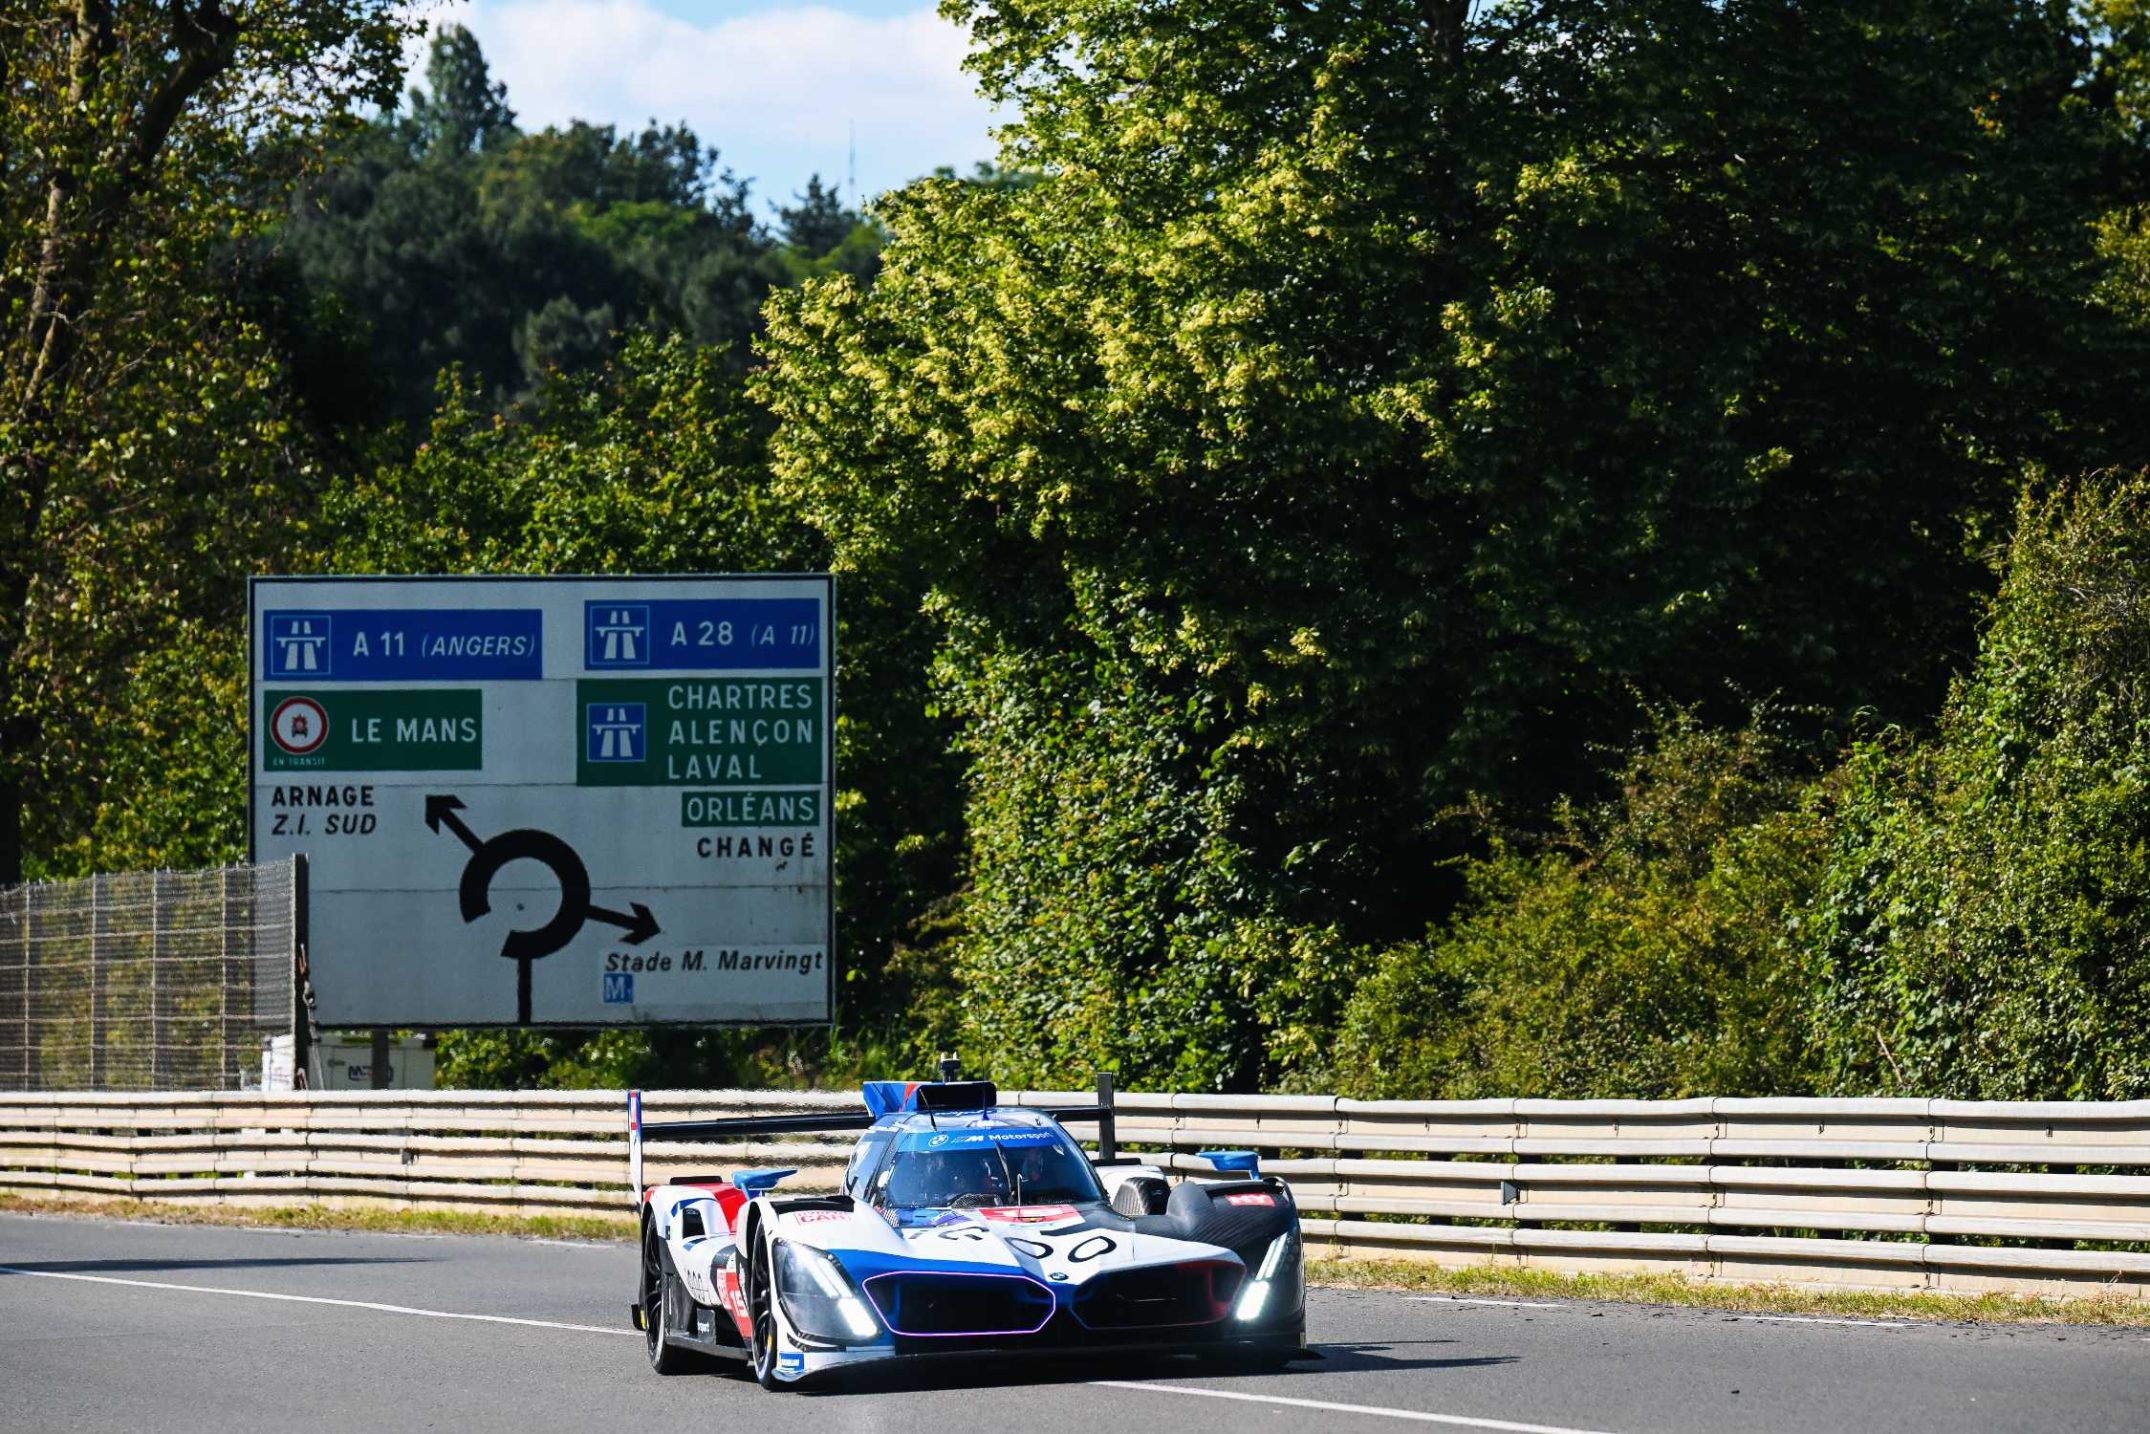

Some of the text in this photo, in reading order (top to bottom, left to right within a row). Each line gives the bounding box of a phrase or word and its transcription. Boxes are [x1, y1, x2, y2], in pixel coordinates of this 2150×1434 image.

[354, 631, 535, 657] A 11 (ANGERS)
[670, 621, 687, 647] A
[697, 621, 734, 646] 28
[668, 684, 813, 710] CHARTRES
[351, 718, 477, 743] LE MANS
[668, 719, 813, 746] ALENÇON
[668, 754, 762, 780] LAVAL
[271, 785, 376, 807] ARNAGE
[687, 792, 815, 822] ORLÉANS
[271, 813, 377, 836] Z.I. SUD
[696, 832, 815, 859] CHANGÉ
[605, 950, 824, 976] Stade M. Marvingt
